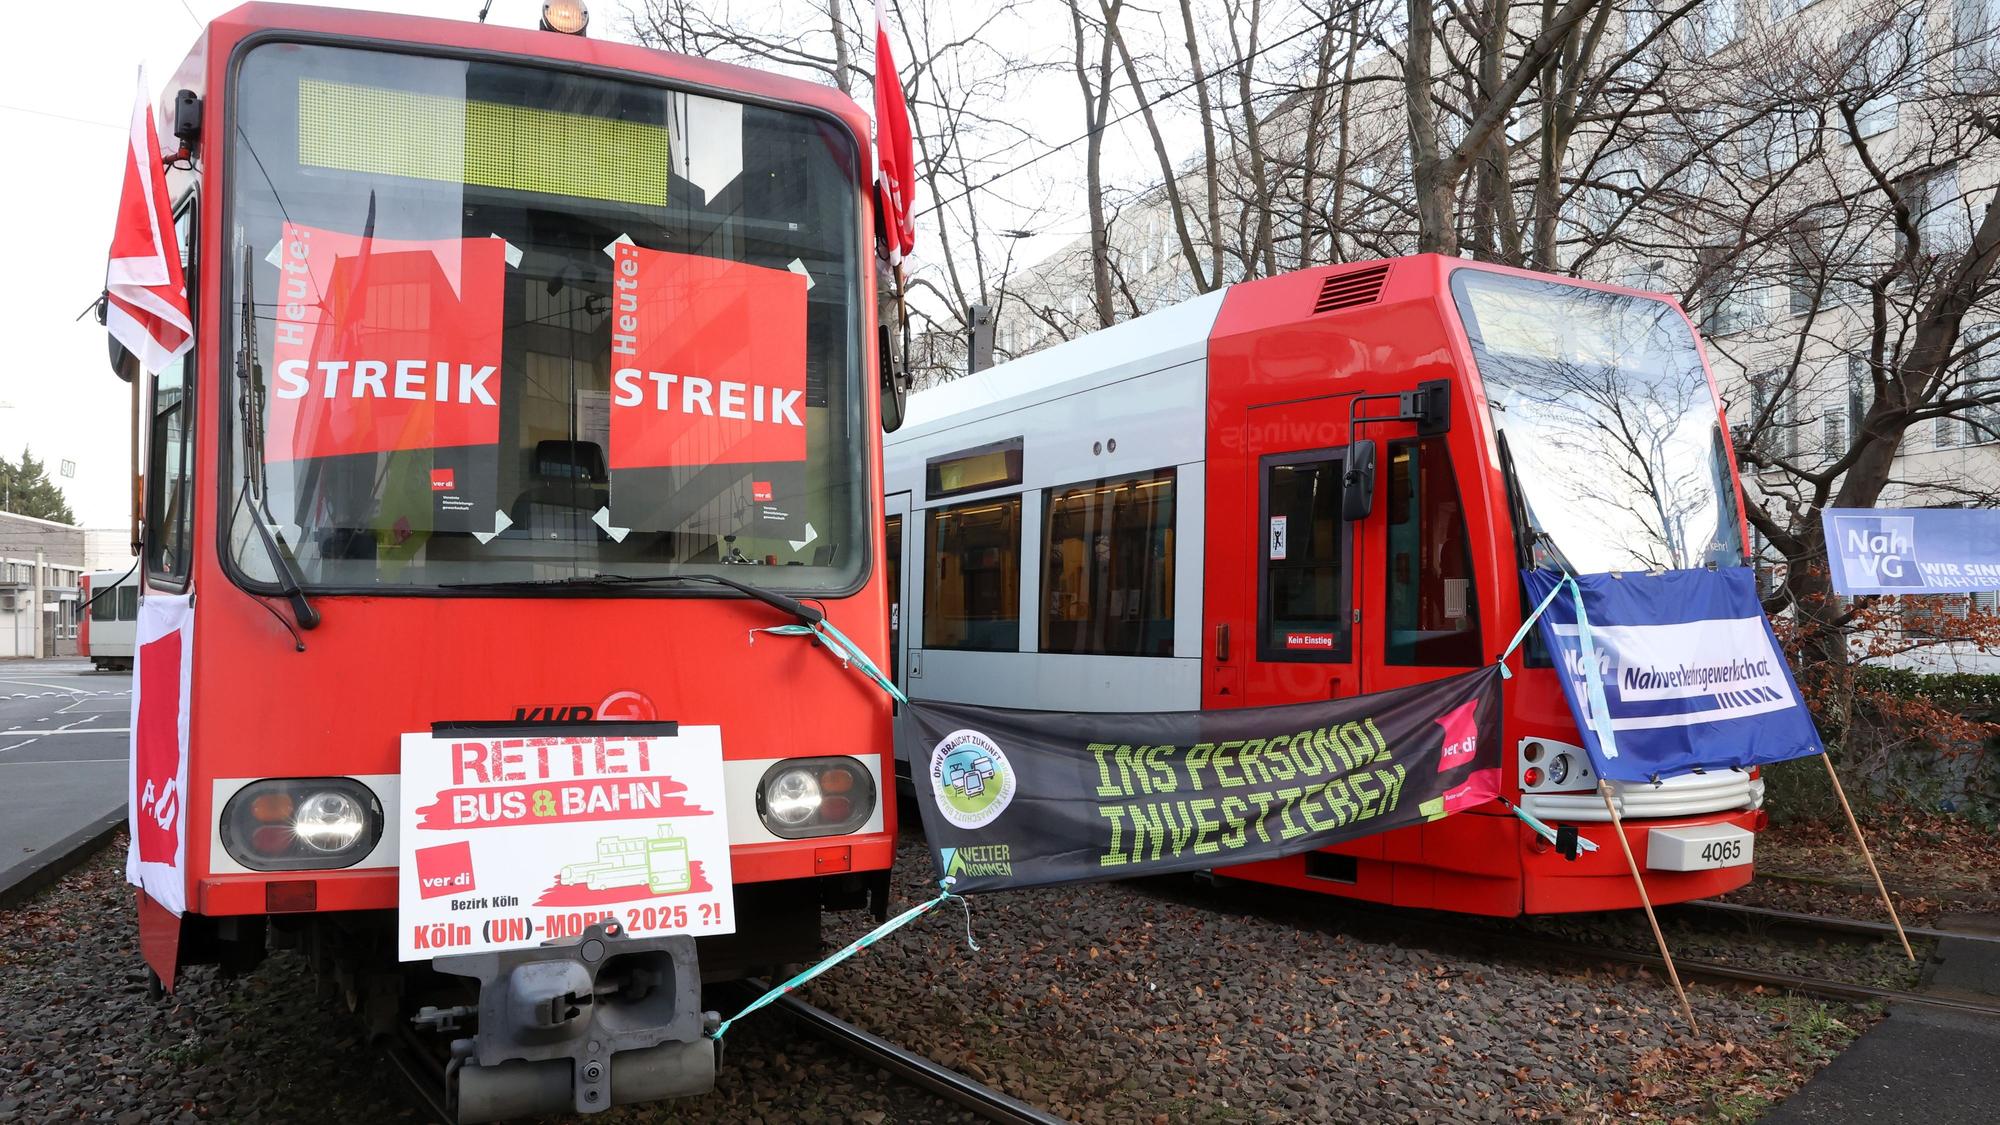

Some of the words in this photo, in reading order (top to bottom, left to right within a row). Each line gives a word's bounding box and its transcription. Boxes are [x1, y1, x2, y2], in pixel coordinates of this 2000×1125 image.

[277, 228, 311, 346] Heute:
[612, 248, 639, 356] Heute:
[276, 359, 497, 406] STREIK
[613, 367, 804, 427] STREIK
[1848, 529, 1907, 554] Nah
[1858, 554, 1904, 578] VG
[1921, 562, 1961, 576] WIR
[1288, 635, 1303, 645] Kein
[1304, 635, 1332, 647] Einstieg
[451, 736, 658, 785] RETTET
[972, 735, 1002, 761] ZUKUNFT
[1088, 741, 1177, 797] INS
[1186, 717, 1392, 793] PERSONAL
[452, 791, 527, 824] BUS
[532, 789, 557, 818] &
[561, 781, 662, 816] BAHN
[1099, 764, 1406, 867] INVESTIEREN
[960, 844, 1010, 862] WEITER
[1701, 840, 1741, 862] 4065
[423, 872, 470, 888] ver.di
[965, 861, 1012, 877] KOMMEN
[451, 897, 488, 911] Bezirk
[492, 895, 519, 908] Köln
[414, 922, 471, 949] Köln
[627, 905, 688, 932] 2025
[698, 902, 721, 926] ?!
